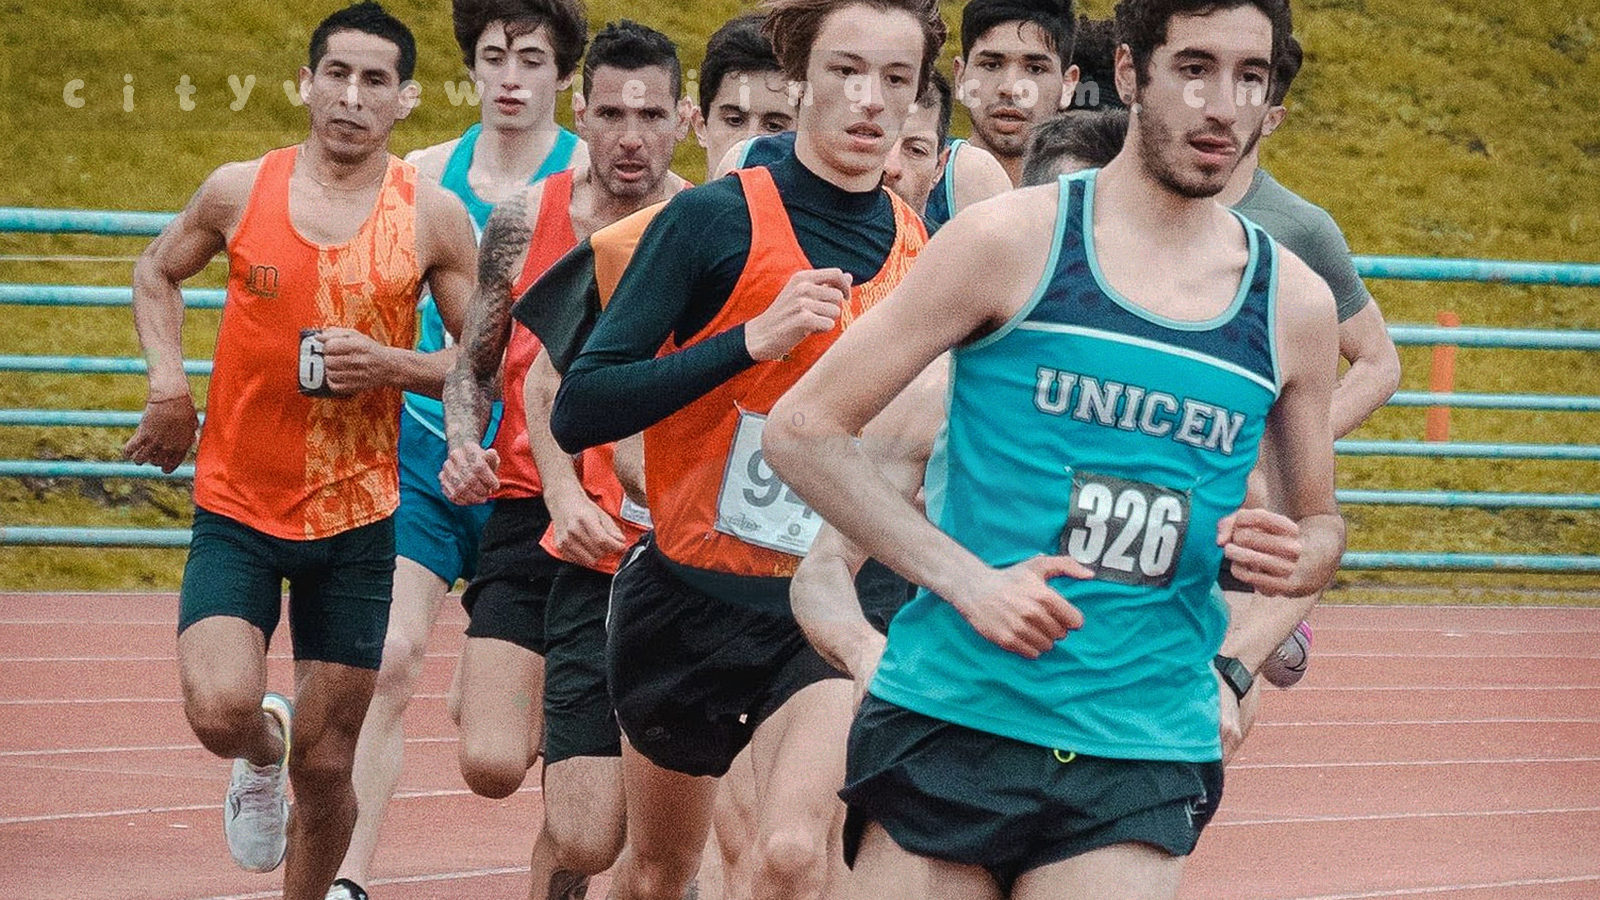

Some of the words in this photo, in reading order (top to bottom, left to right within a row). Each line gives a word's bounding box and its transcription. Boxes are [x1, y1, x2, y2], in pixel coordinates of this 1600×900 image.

[300, 336, 324, 390] 6
[1033, 366, 1247, 456] UNICEN
[1067, 482, 1183, 577] 326
